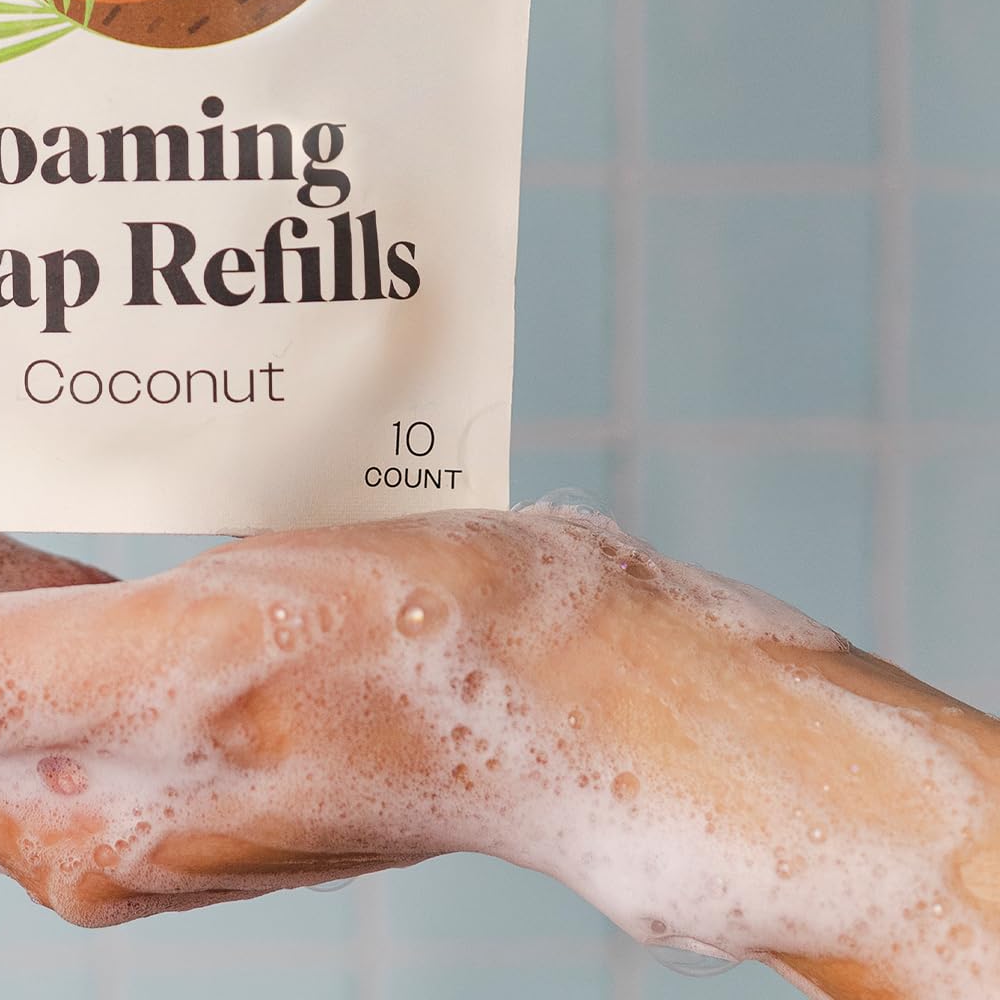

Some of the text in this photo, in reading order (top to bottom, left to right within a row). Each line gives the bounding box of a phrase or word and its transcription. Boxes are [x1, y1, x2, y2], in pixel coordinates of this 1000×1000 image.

[124, 209, 421, 307] Refills
[24, 359, 285, 405] Coconut
[392, 420, 435, 457] 10
[364, 466, 463, 490] COUNT
